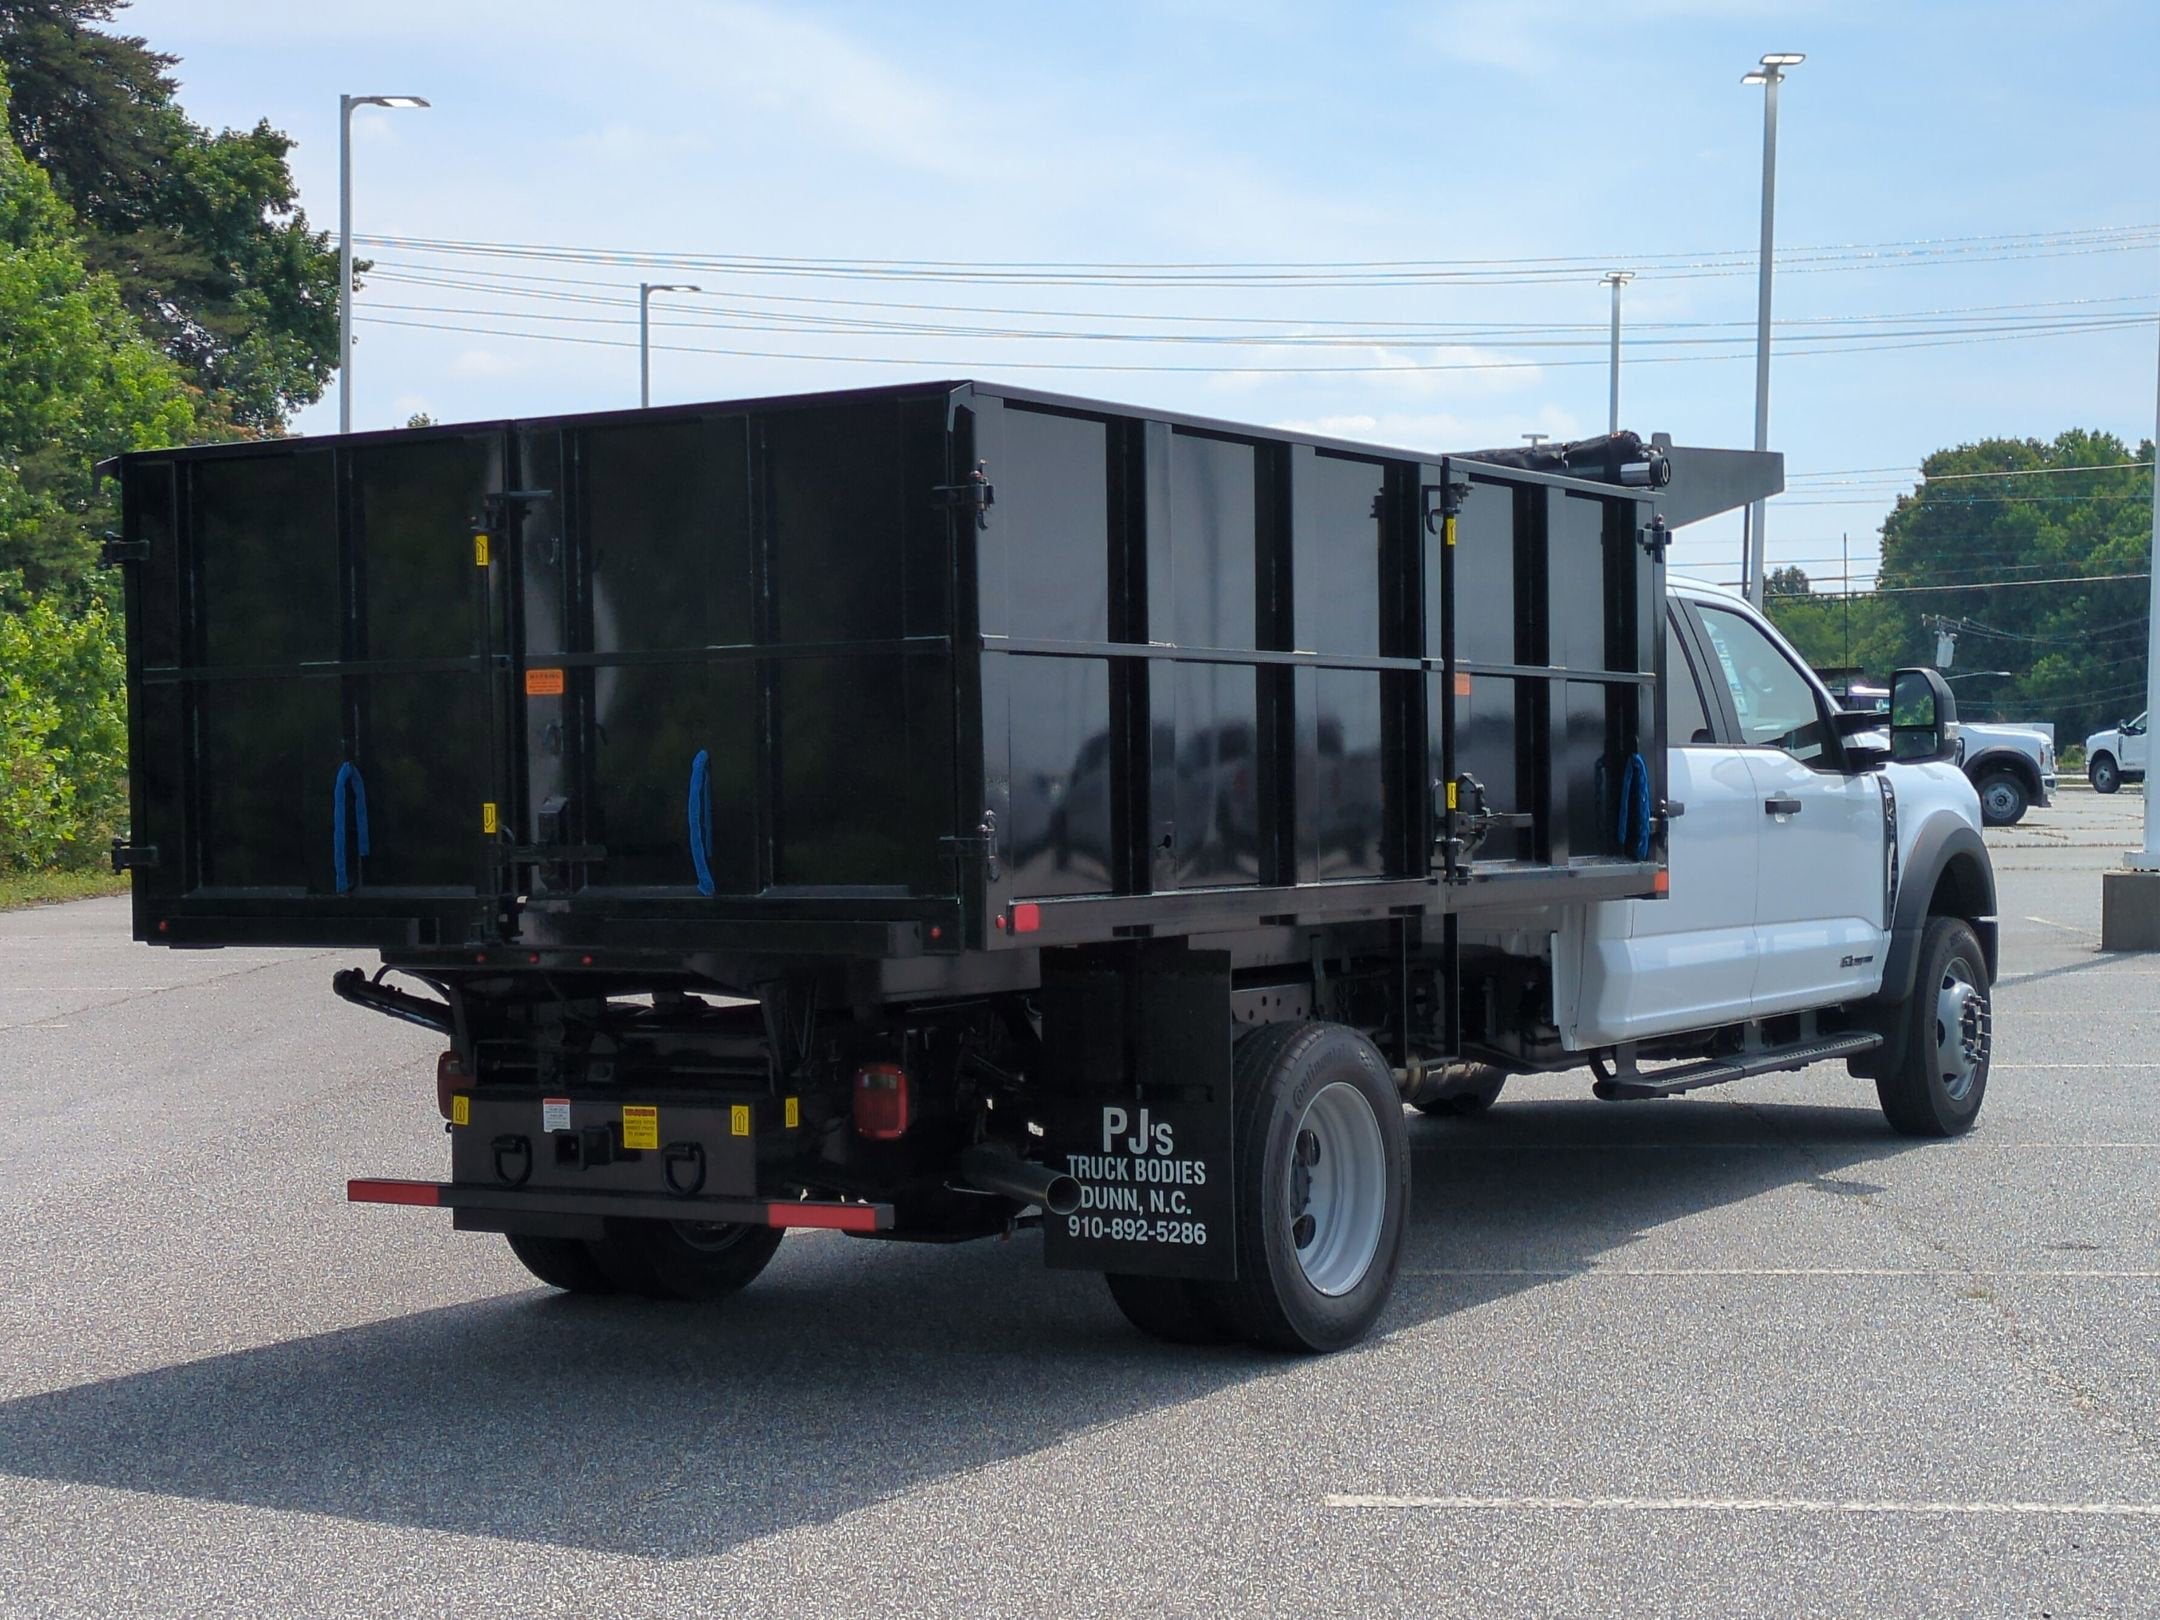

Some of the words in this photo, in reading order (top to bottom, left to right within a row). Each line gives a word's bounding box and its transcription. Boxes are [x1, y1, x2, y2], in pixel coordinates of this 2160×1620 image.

[1066, 1155, 1129, 1180] TRUCK
[1135, 1159, 1206, 1185] BODIES
[1081, 1186, 1144, 1216] DUNN,
[1150, 1189, 1192, 1215] N.C.
[1068, 1216, 1207, 1245] 910-892-5286
